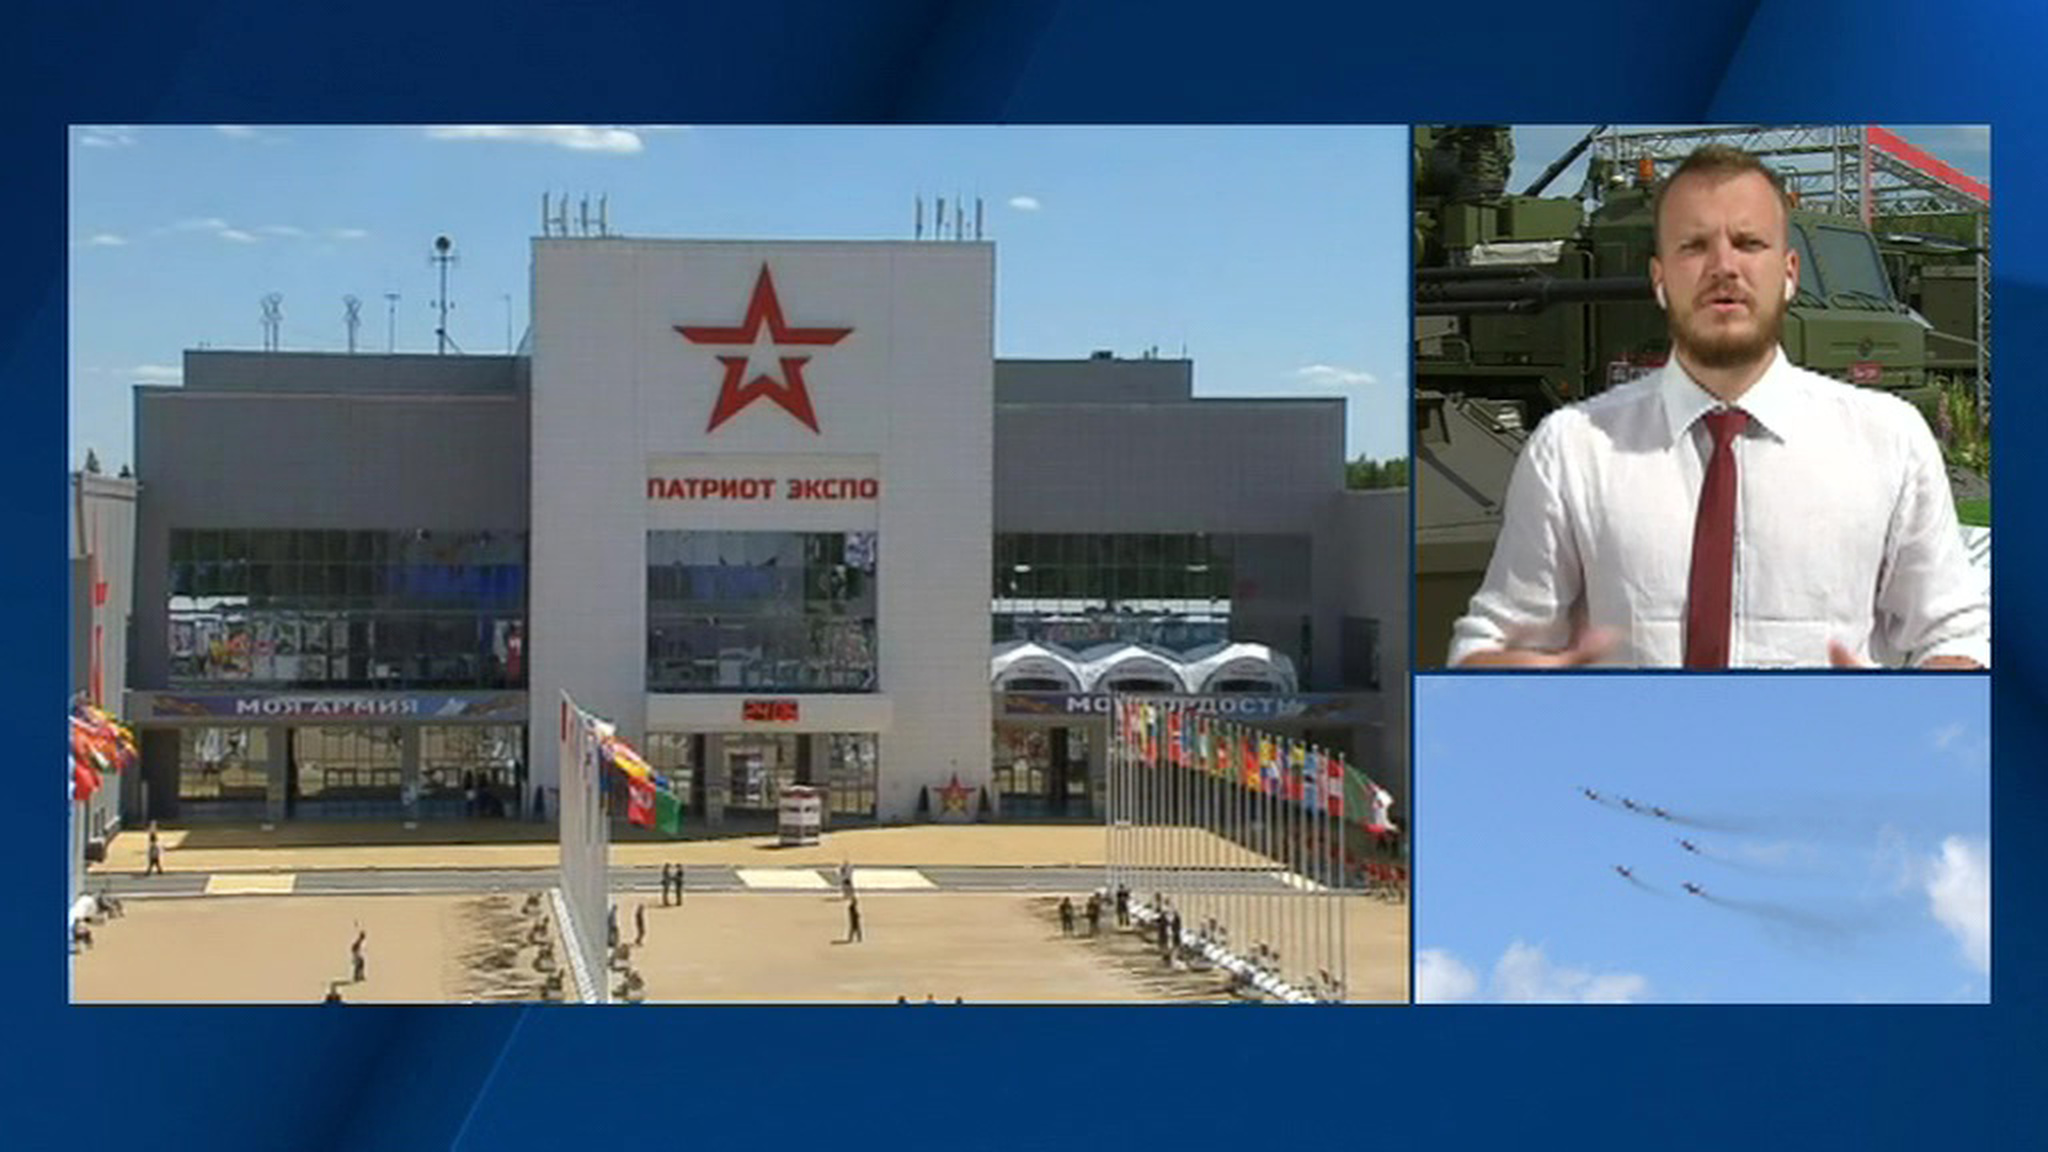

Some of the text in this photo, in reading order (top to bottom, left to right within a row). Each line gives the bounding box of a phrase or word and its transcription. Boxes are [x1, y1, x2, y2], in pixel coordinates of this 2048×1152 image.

[647, 477, 880, 500] ПАТРИОТ ЭКСПО
[236, 697, 418, 716] МОЯ АРМИЯ
